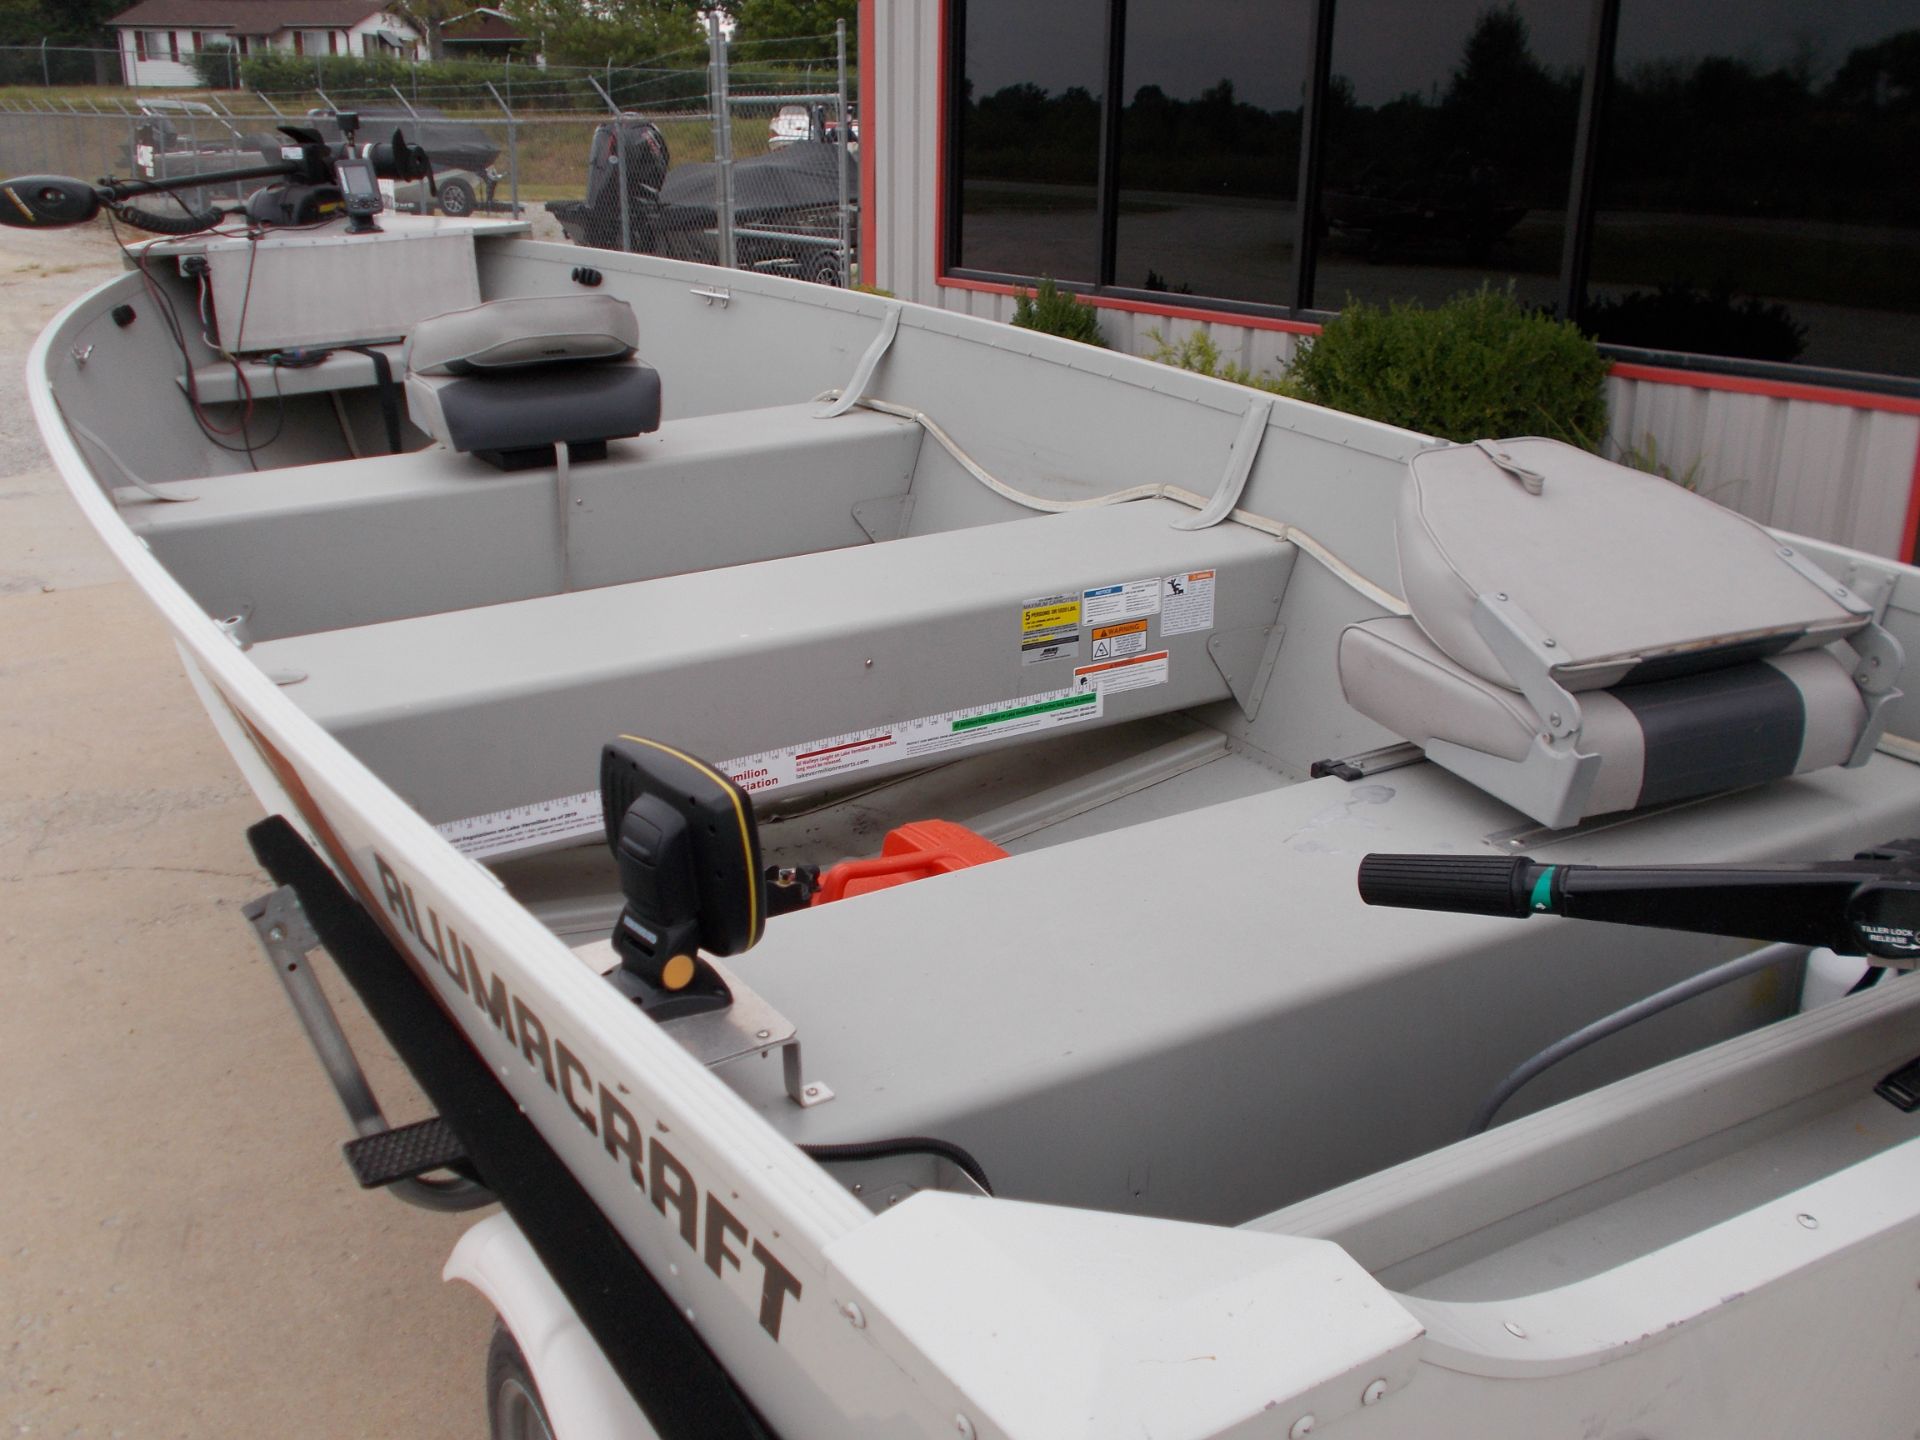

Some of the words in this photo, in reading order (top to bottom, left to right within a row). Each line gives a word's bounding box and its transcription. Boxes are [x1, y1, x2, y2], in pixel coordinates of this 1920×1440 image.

[1025, 612, 1030, 620] 5
[1108, 624, 1140, 636] WARNING
[741, 777, 779, 792] ciation
[1861, 925, 1889, 934] TILLER
[1870, 934, 1908, 944] RELEASE
[374, 853, 802, 1342] ALUMACRAFT
